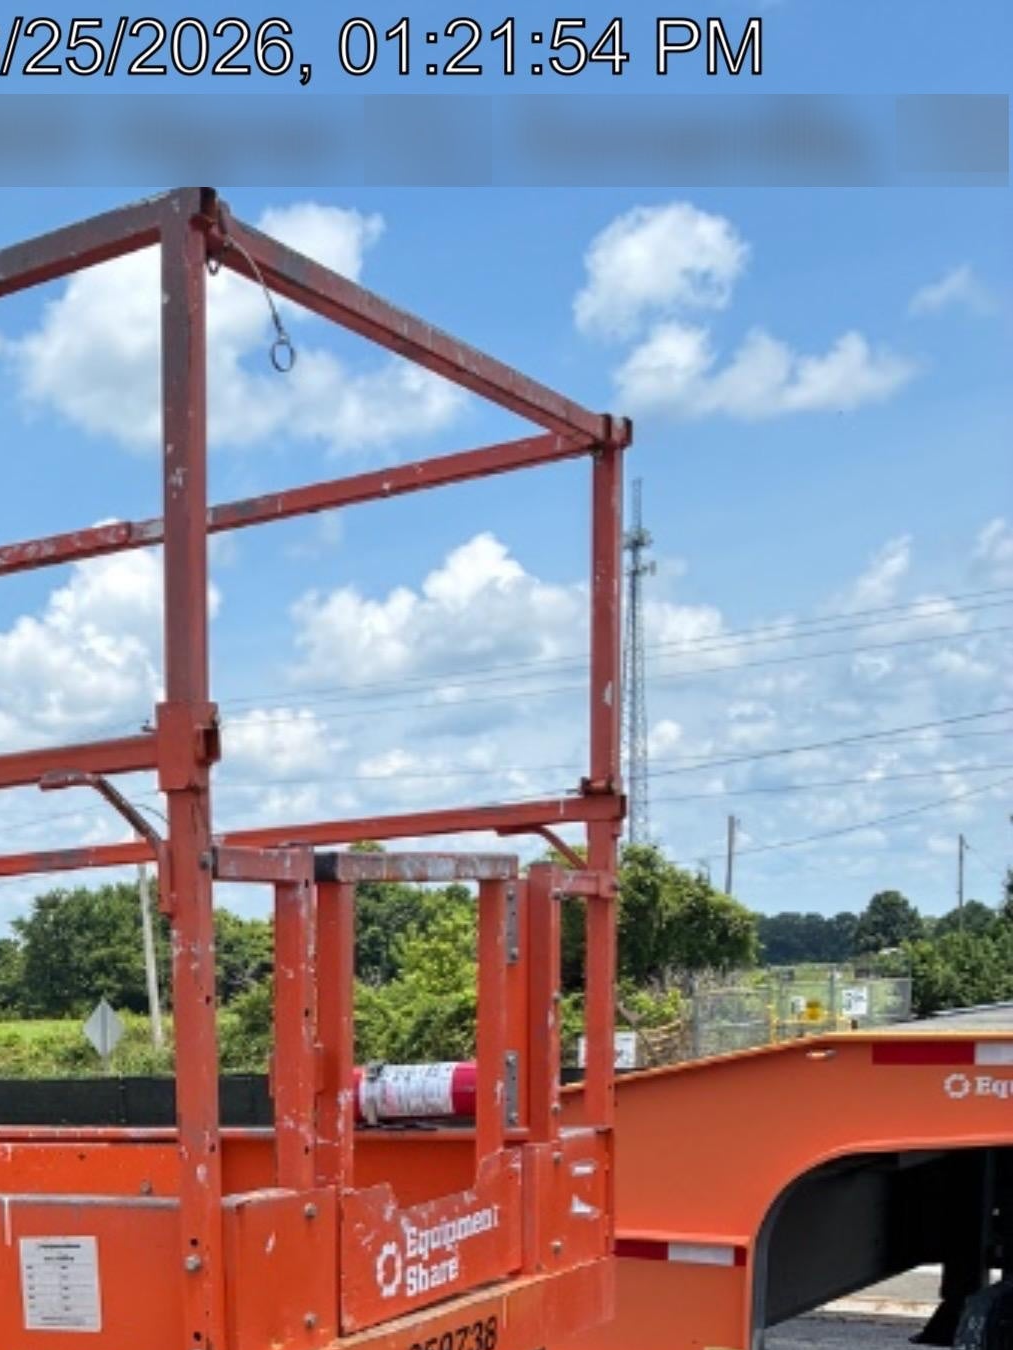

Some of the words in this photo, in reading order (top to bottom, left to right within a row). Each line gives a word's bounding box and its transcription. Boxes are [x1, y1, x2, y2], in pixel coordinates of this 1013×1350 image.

[973, 1074, 1013, 1100] Eq
[404, 1205, 500, 1259] Equipment
[405, 1258, 459, 1298] Share
